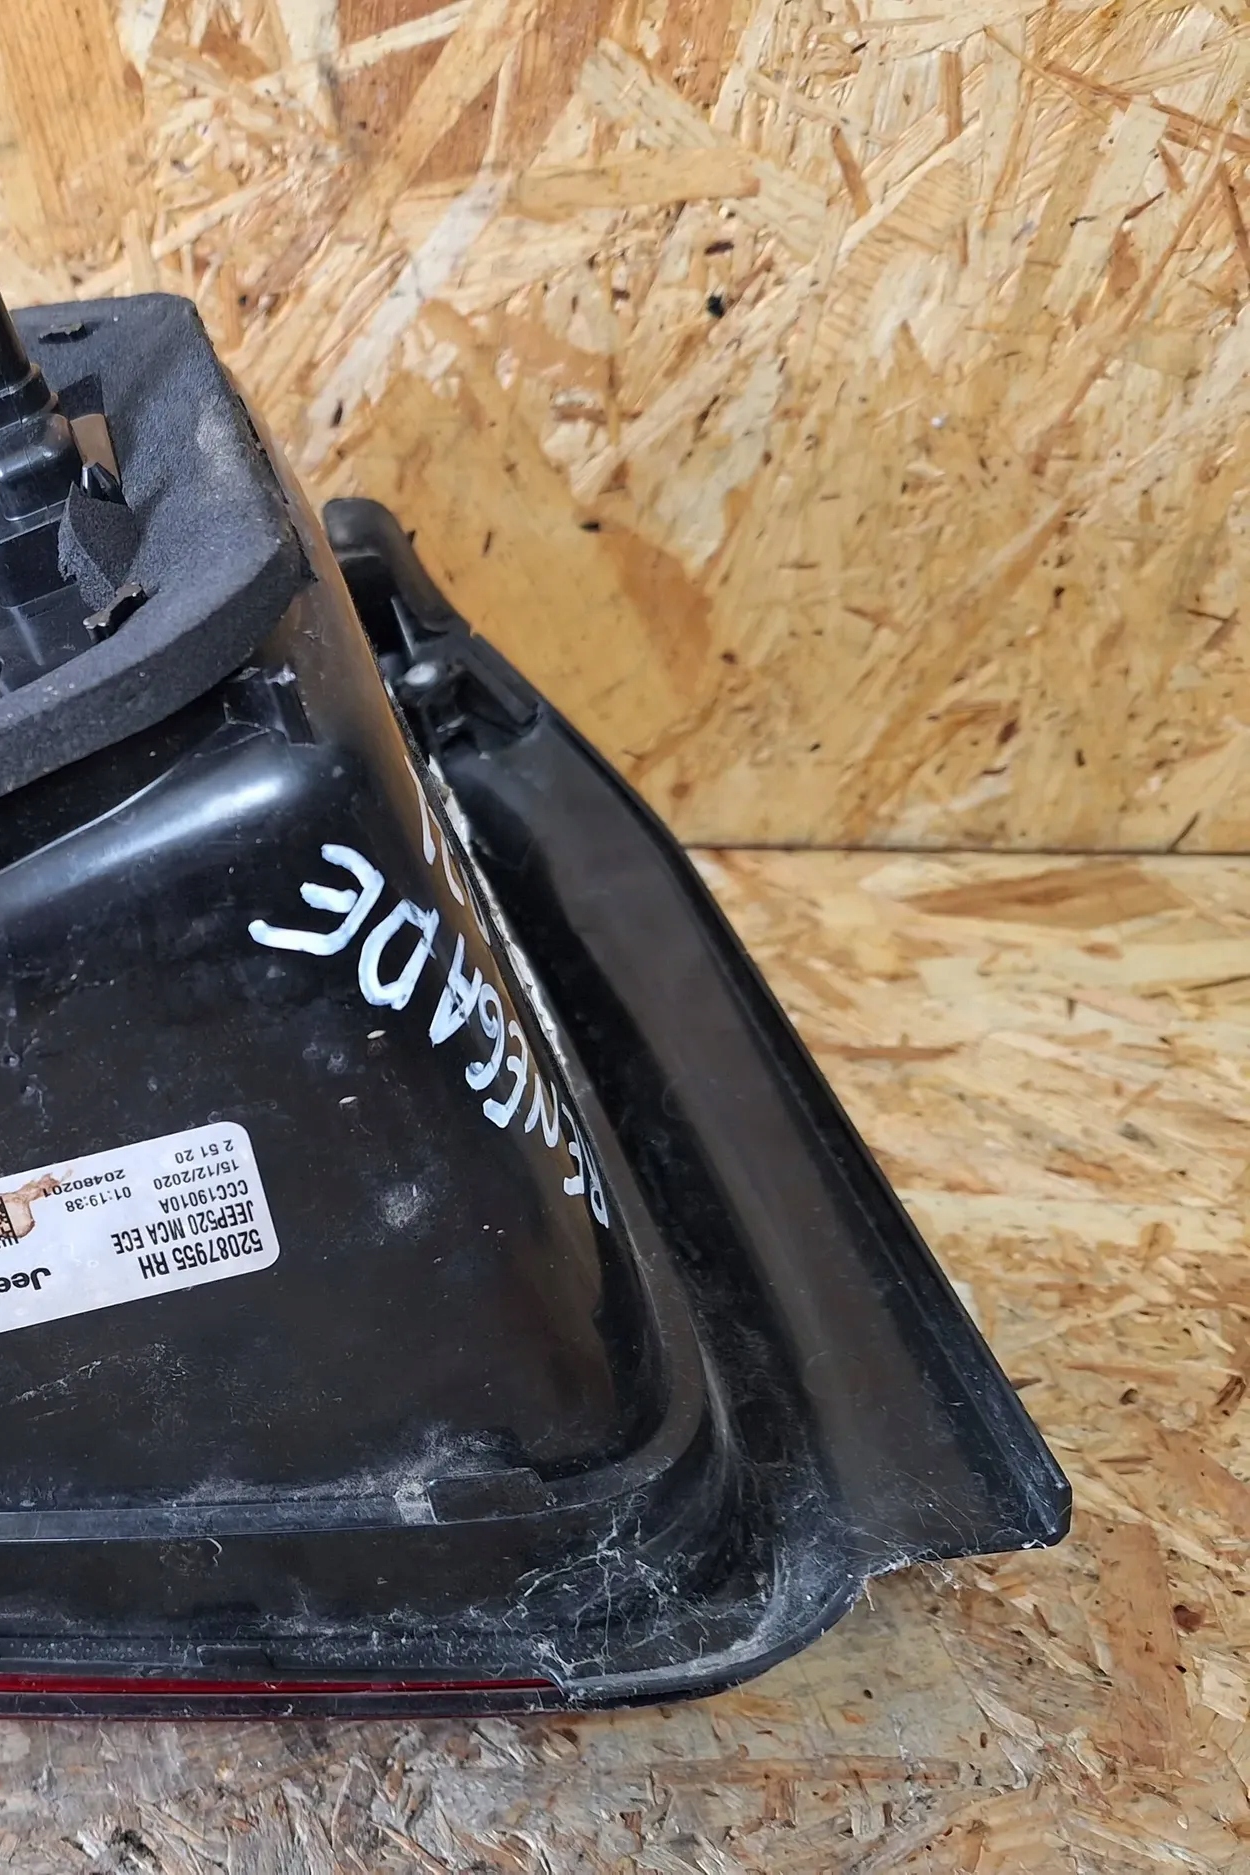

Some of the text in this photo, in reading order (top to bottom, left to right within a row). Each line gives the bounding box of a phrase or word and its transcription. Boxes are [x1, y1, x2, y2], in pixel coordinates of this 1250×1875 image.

[249, 844, 610, 1229] RENEGADE
[175, 1139, 233, 1164] 2 51 20
[42, 1169, 125, 1197] 20480201
[153, 1159, 240, 1190] 15/12/2020
[65, 1186, 131, 1212] 01:19:38
[158, 1179, 248, 1213] CCC19010A
[111, 1200, 254, 1255] JEEP520 MCA ECE
[138, 1229, 263, 1279] 52087955 RH
